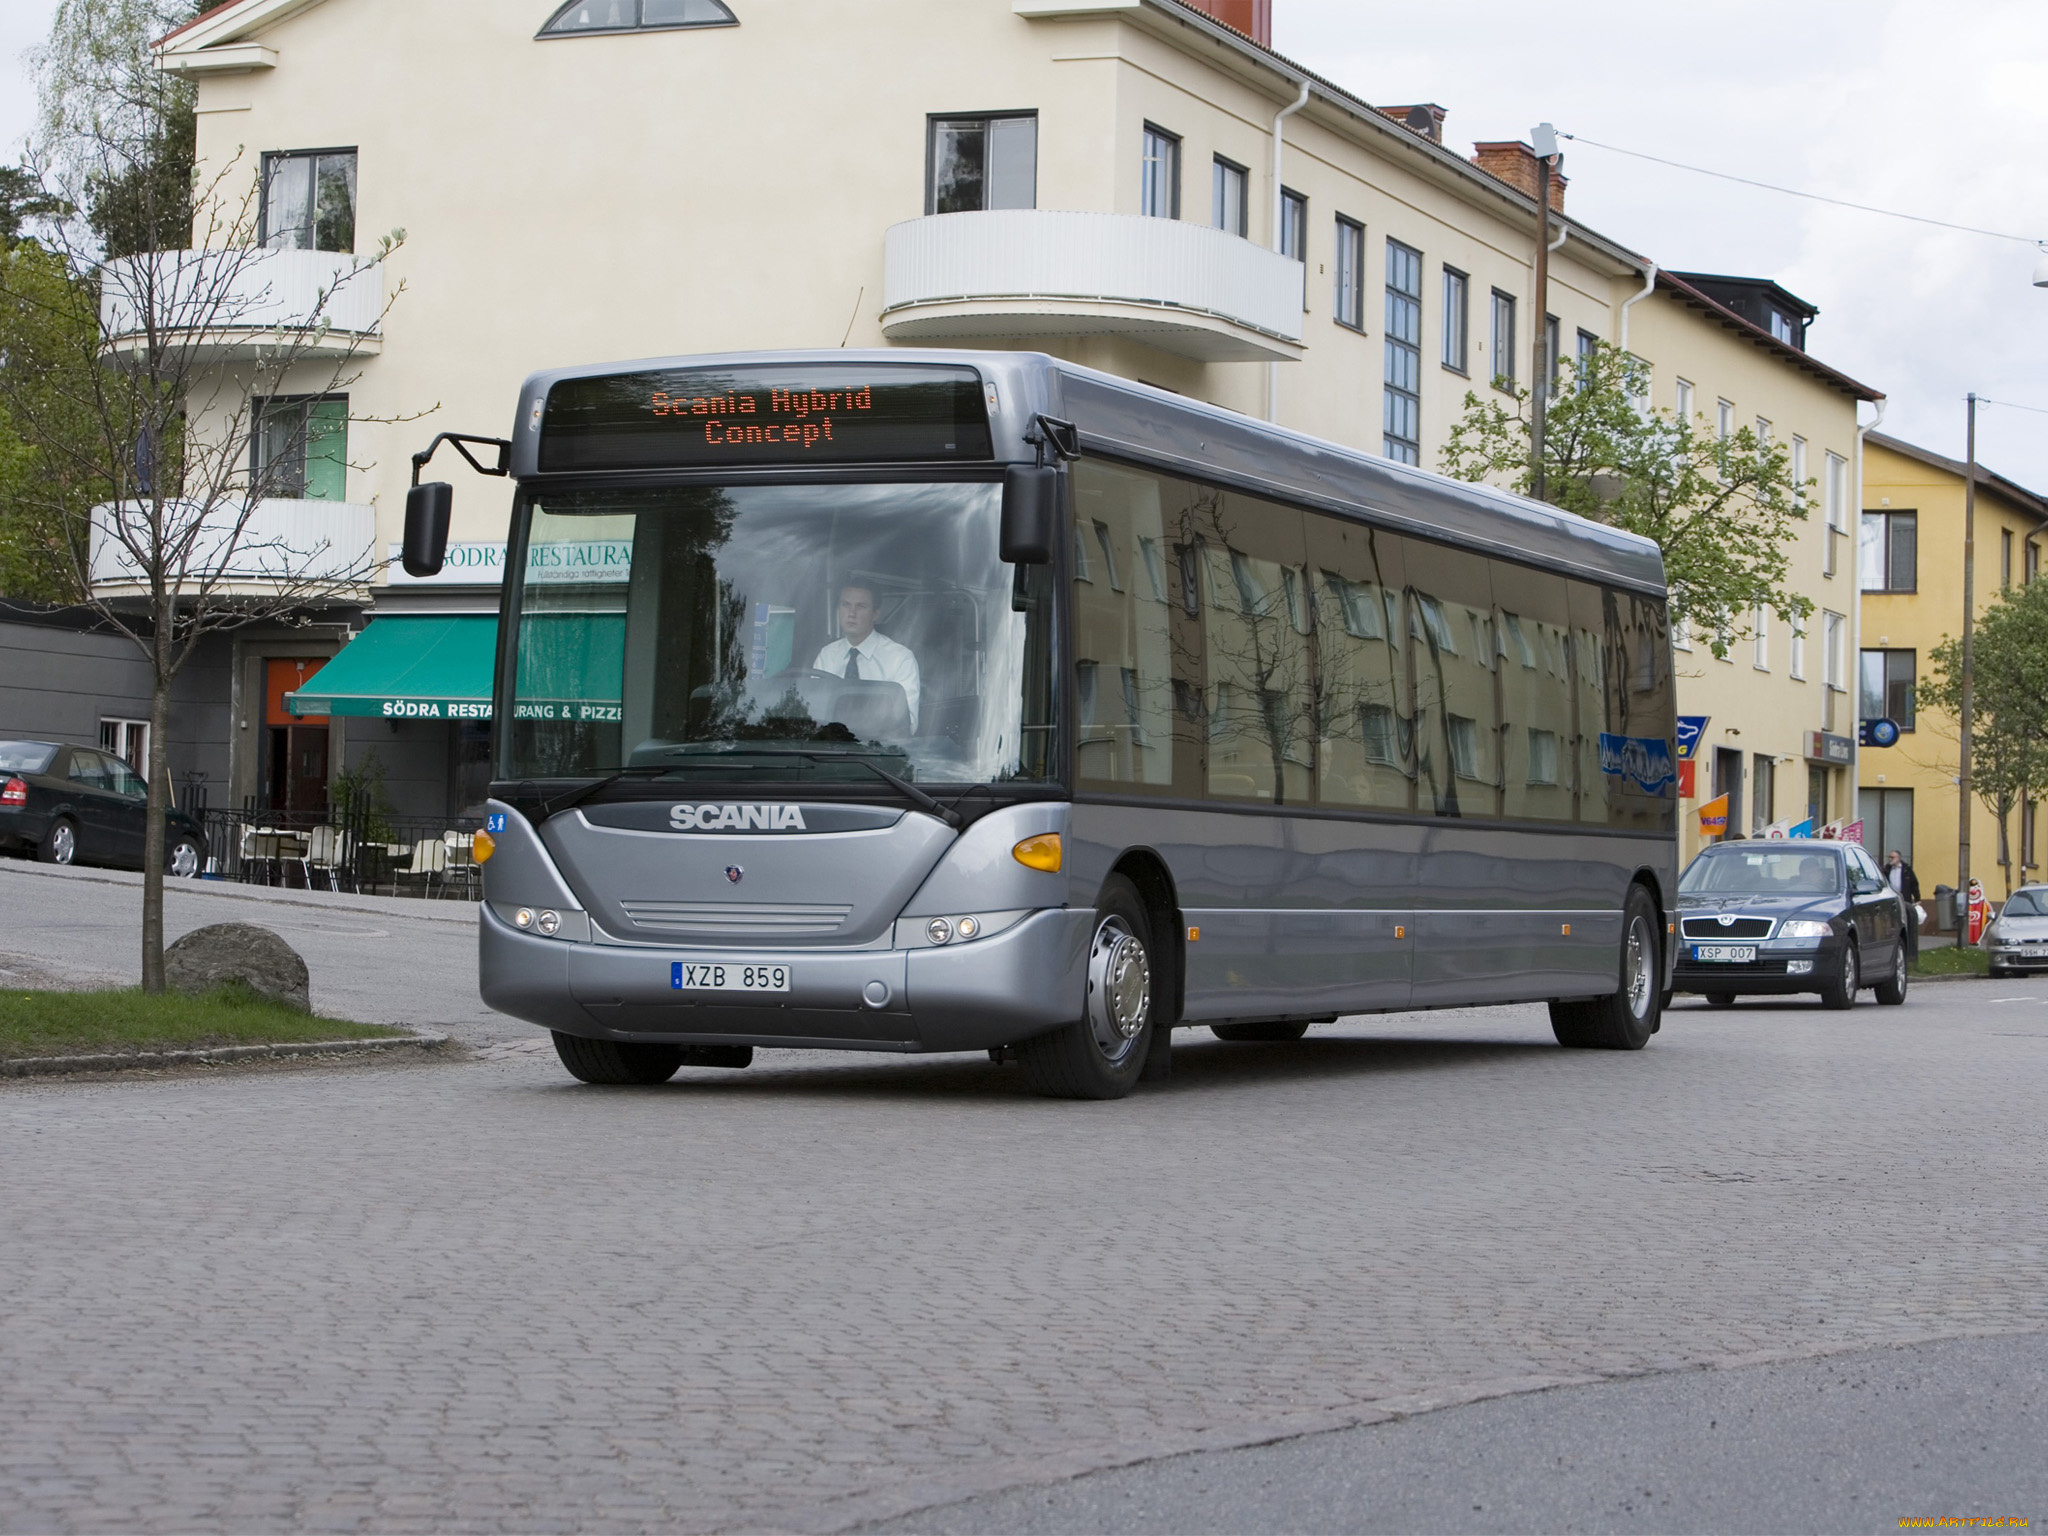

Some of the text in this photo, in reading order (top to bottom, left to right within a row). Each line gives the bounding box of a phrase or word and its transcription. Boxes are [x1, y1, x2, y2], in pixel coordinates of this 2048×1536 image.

[652, 384, 872, 418] Scania Hybrid
[705, 416, 833, 448] Concept
[382, 700, 440, 717] SÖDRA
[562, 705, 571, 718] &
[669, 805, 807, 830] SCANIA
[1700, 948, 1753, 959] XSP 007
[686, 965, 785, 989] XZB 859
